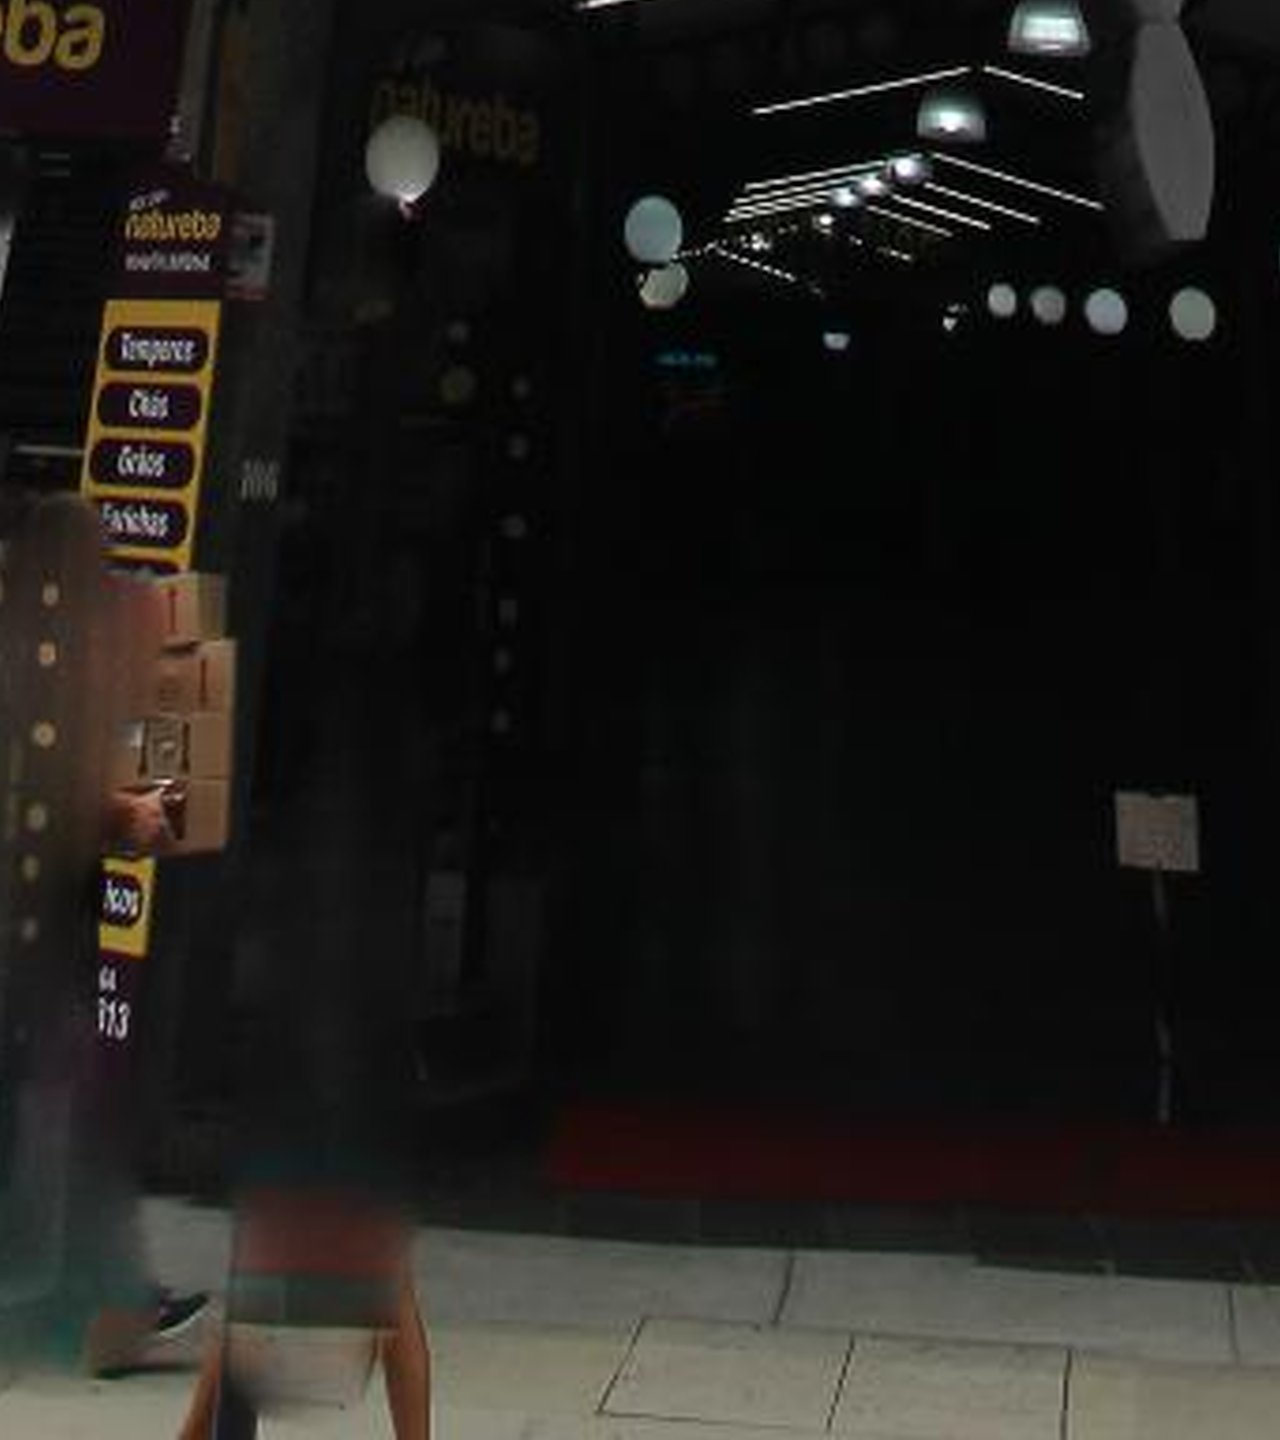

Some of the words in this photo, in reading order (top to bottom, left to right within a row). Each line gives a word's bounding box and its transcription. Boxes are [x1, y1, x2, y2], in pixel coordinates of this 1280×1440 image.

[124, 207, 223, 242] natureba
[128, 389, 170, 419] Chás
[116, 444, 167, 478] Grãos
